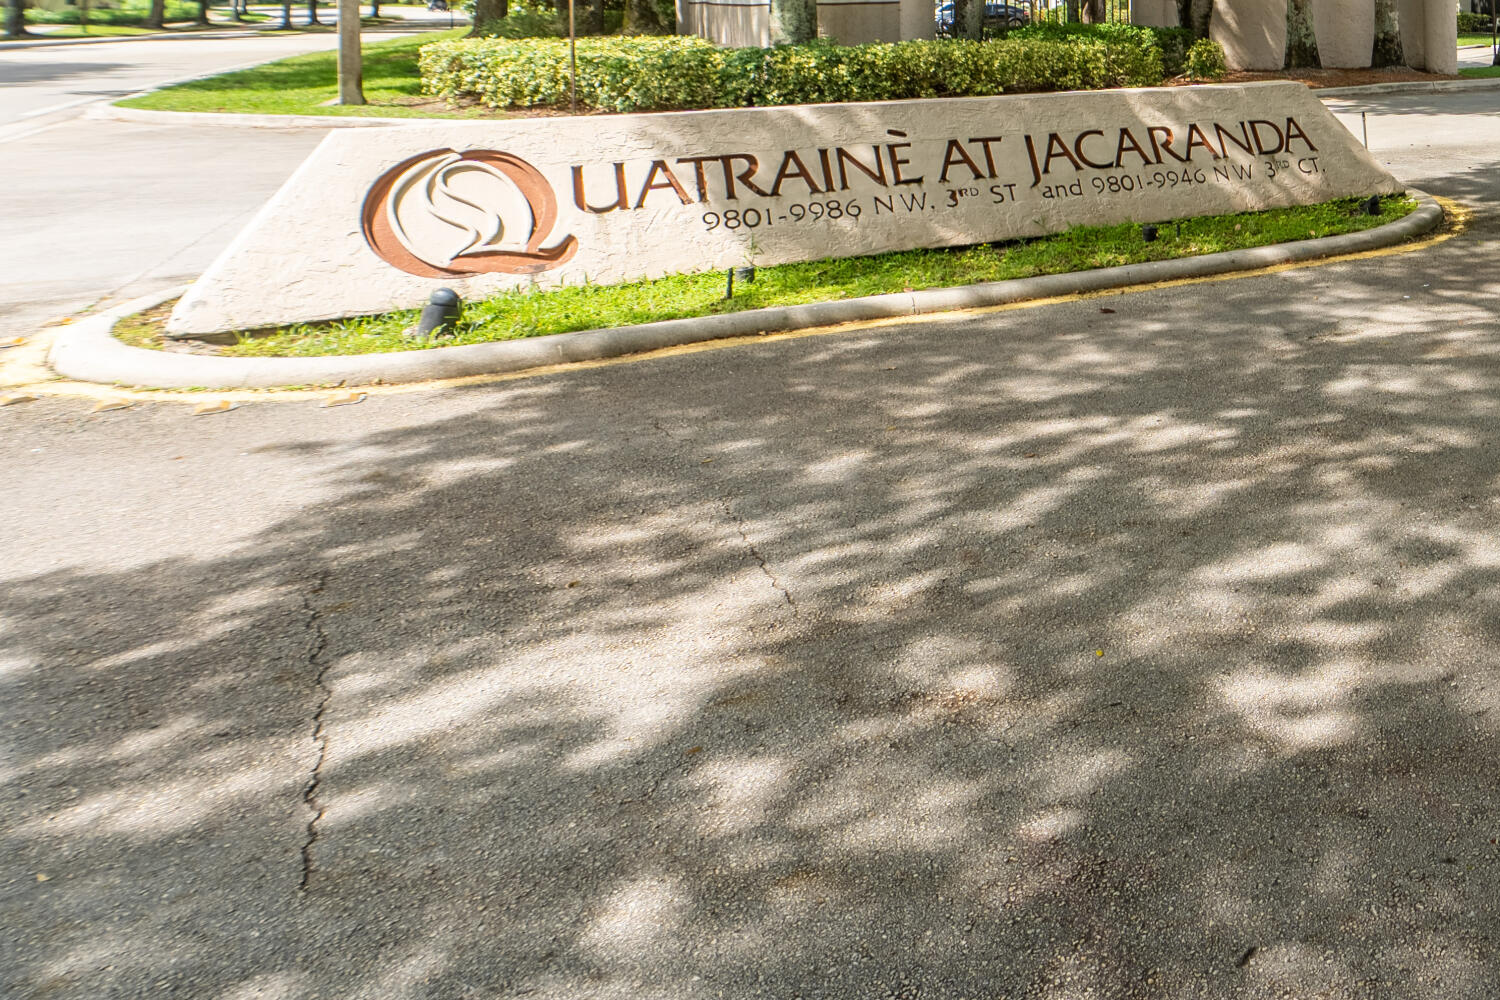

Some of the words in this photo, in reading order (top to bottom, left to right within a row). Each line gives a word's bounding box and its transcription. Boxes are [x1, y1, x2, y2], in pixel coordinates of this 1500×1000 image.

[939, 136, 1002, 184] AT
[1024, 117, 1319, 190] JACARANDA
[702, 198, 862, 231] 9801-9986
[990, 183, 1017, 204] ST
[1042, 178, 1082, 199] and
[1091, 168, 1207, 194] 9801-9946
[1213, 164, 1253, 183] NW
